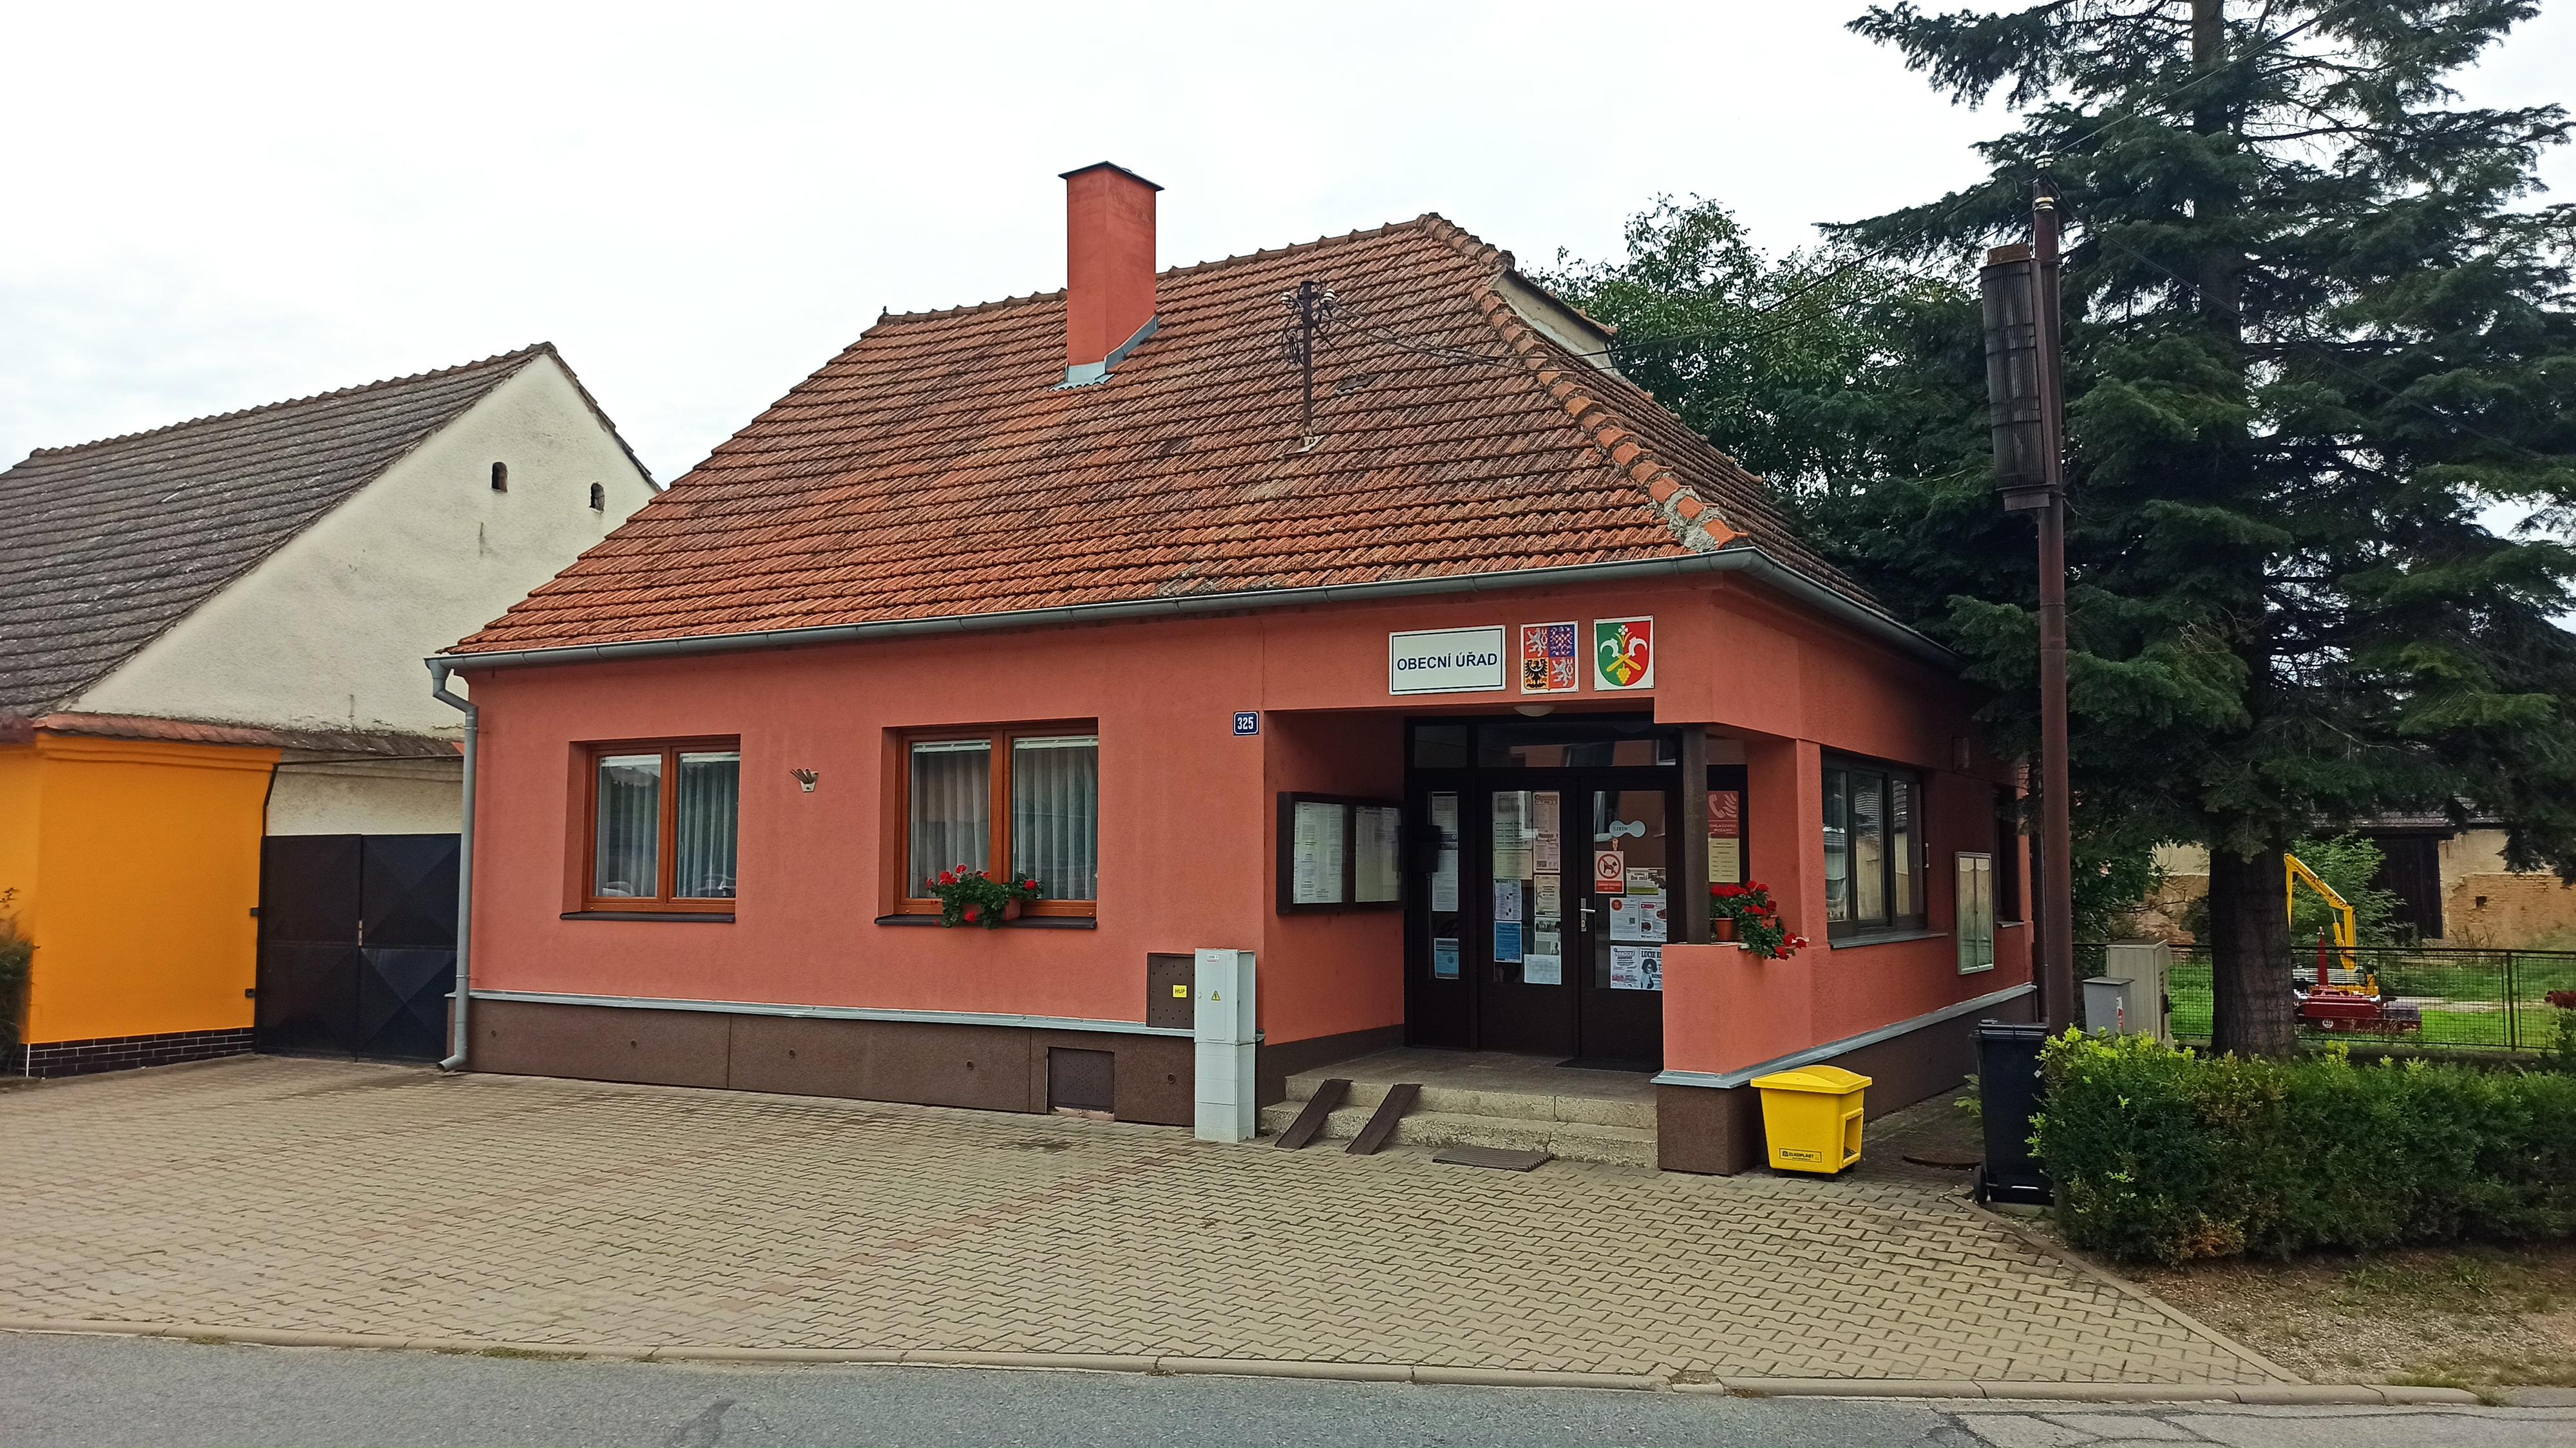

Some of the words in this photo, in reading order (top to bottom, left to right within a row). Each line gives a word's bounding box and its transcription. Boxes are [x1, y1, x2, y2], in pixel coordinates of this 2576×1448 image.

[1397, 653, 1452, 671] OBECNÍ
[1456, 652, 1498, 668] ÚŘAD
[1237, 717, 1254, 729] 325
